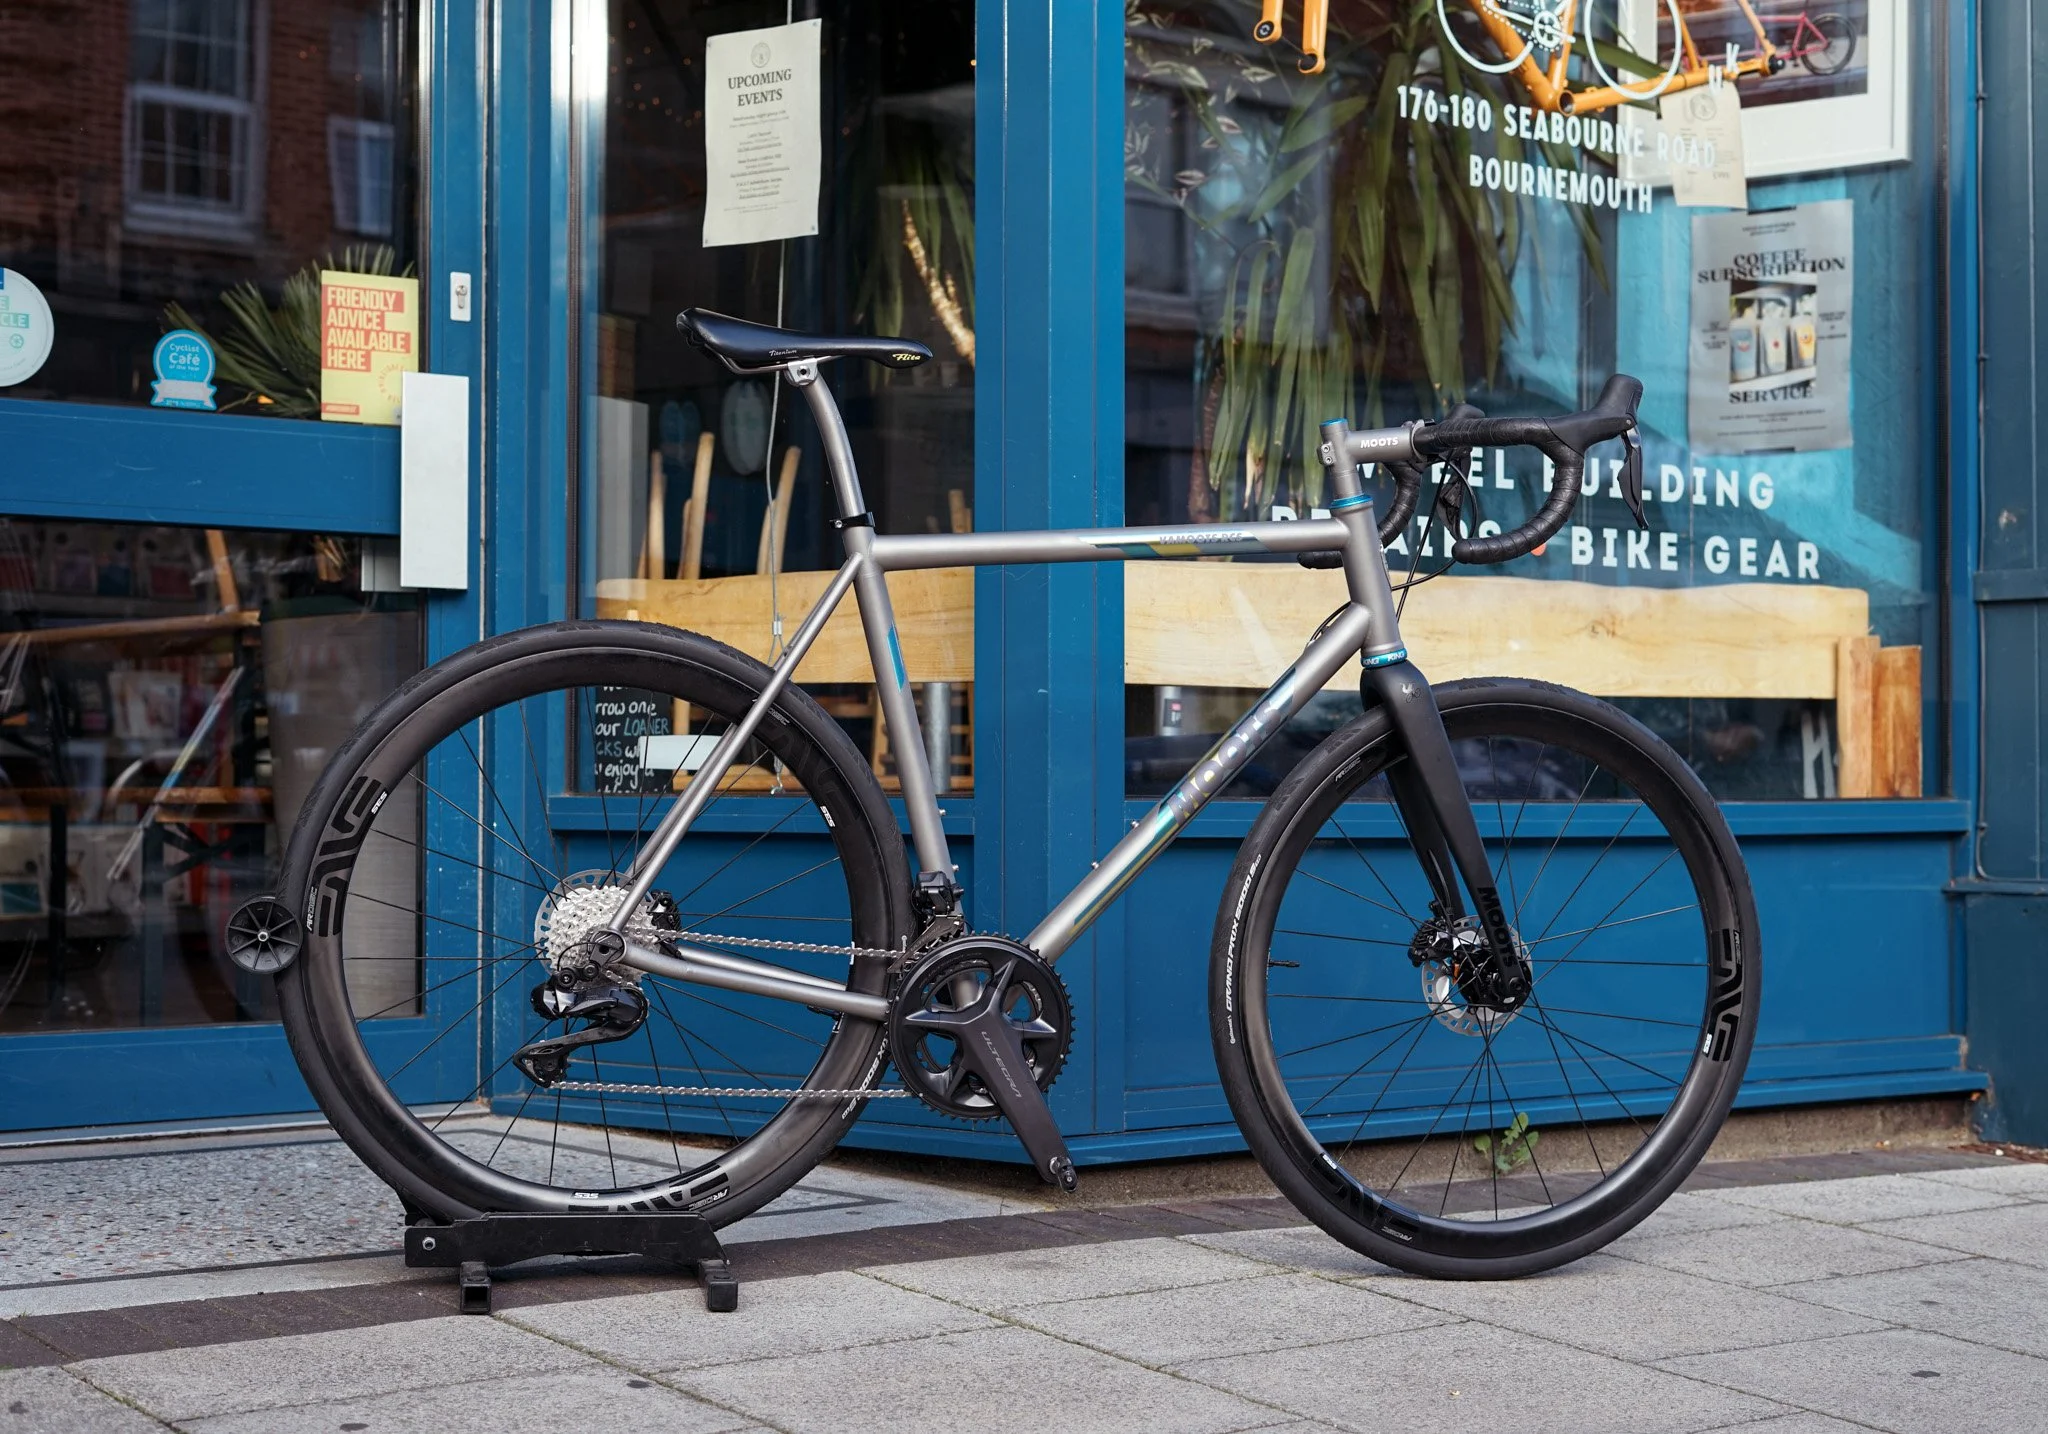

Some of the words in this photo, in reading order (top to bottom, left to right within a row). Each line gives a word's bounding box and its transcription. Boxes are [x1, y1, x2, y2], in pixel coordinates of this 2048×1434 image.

[727, 68, 792, 90] UPCOMING
[737, 88, 783, 107] EVENTS
[1397, 84, 1492, 132] 176-180
[1503, 103, 1645, 158] SEABOURNE
[1656, 131, 1716, 169] ROAD
[1469, 154, 1653, 214] BOURNEMOUTH
[1697, 256, 1846, 284] SUBSCRIPTION
[1733, 248, 1806, 270] COFFEE
[327, 286, 397, 312] FRIENDLY
[326, 307, 382, 331] ADVICE
[169, 343, 200, 353] Cyclist
[326, 328, 407, 353] AVAILABLE
[168, 352, 201, 366] Café
[327, 348, 367, 371] HERE
[892, 353, 921, 362] Flite
[1729, 383, 1814, 405] SERVICE
[1360, 436, 1399, 448] MOOTS
[1159, 534, 1218, 545] VAMOOTS
[1571, 525, 1680, 572] BIKE
[1703, 534, 1821, 580] GEAR
[628, 701, 657, 716] one
[623, 717, 670, 737] LOANER
[604, 759, 640, 790] enjoy
[1166, 700, 1282, 826] MOOTS
[1234, 874, 1253, 921] 5000
[1227, 918, 1240, 959] PRIX
[1477, 887, 1520, 968] MOOTS
[1225, 956, 1234, 1013] GRAND
[980, 1030, 1023, 1098] ULTEGRA
